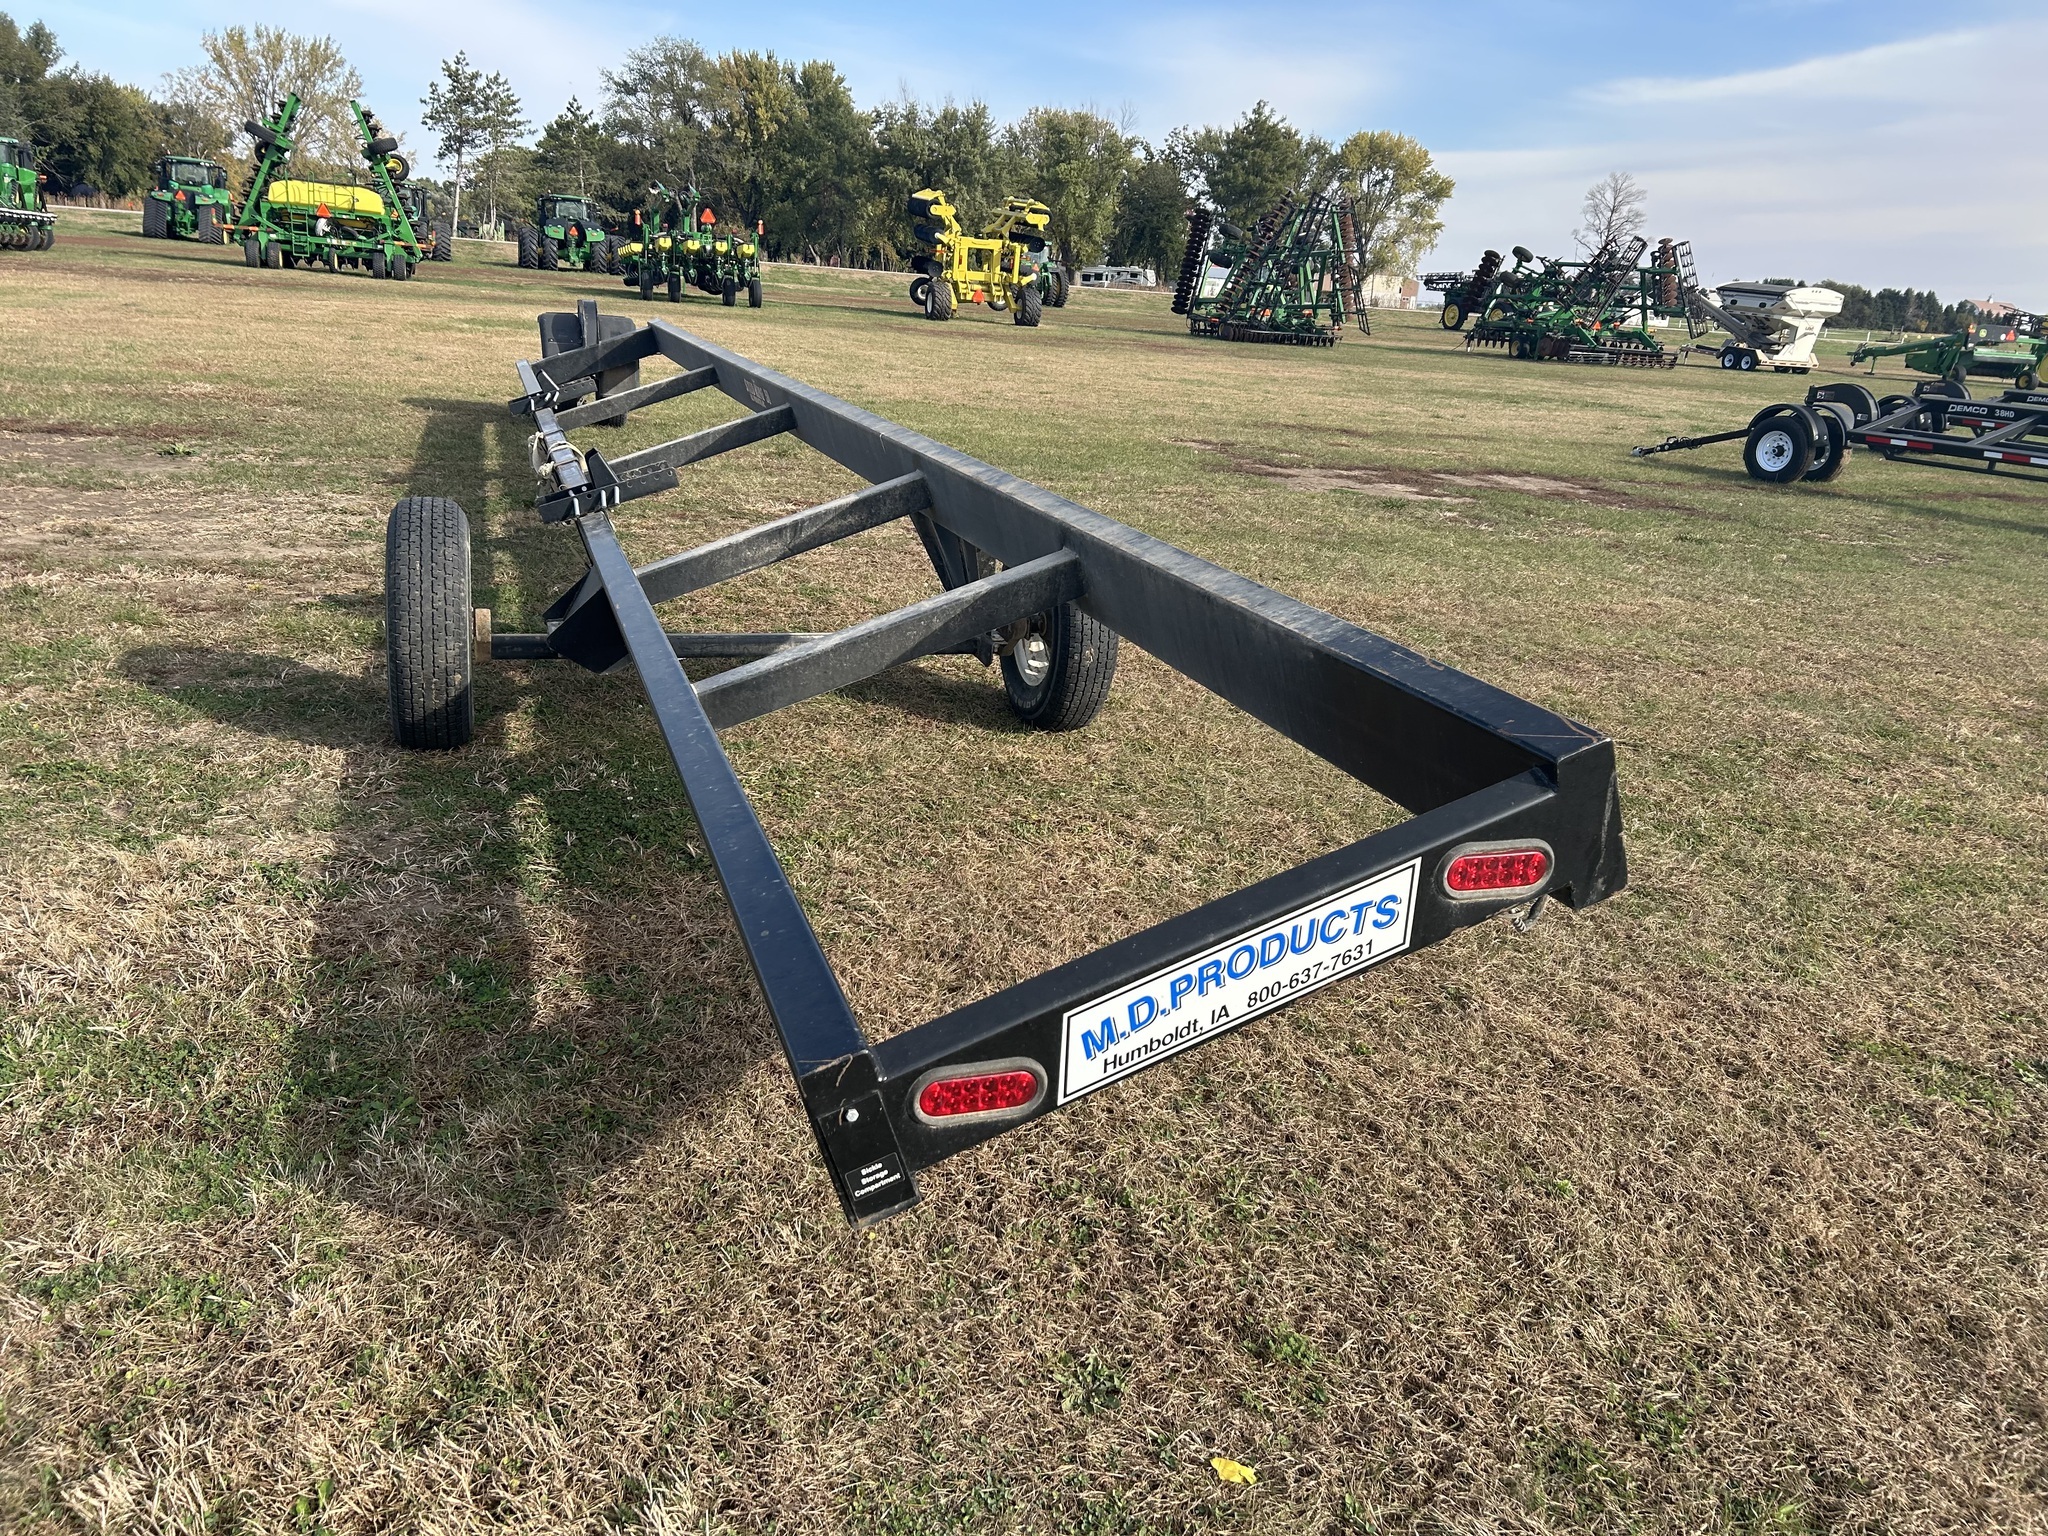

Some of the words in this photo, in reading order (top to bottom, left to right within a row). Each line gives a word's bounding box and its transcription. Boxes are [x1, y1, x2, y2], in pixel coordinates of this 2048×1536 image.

[1947, 404, 1988, 415] DEMCO
[1994, 408, 2015, 418] 38HD
[1103, 1019, 1203, 1073] Humboldt,
[1211, 1005, 1230, 1025] IA
[1247, 939, 1373, 1008] 800-637-7631
[861, 1163, 883, 1176] Sickle
[855, 1173, 901, 1197] Compartment
[861, 1170, 889, 1185] Storage
